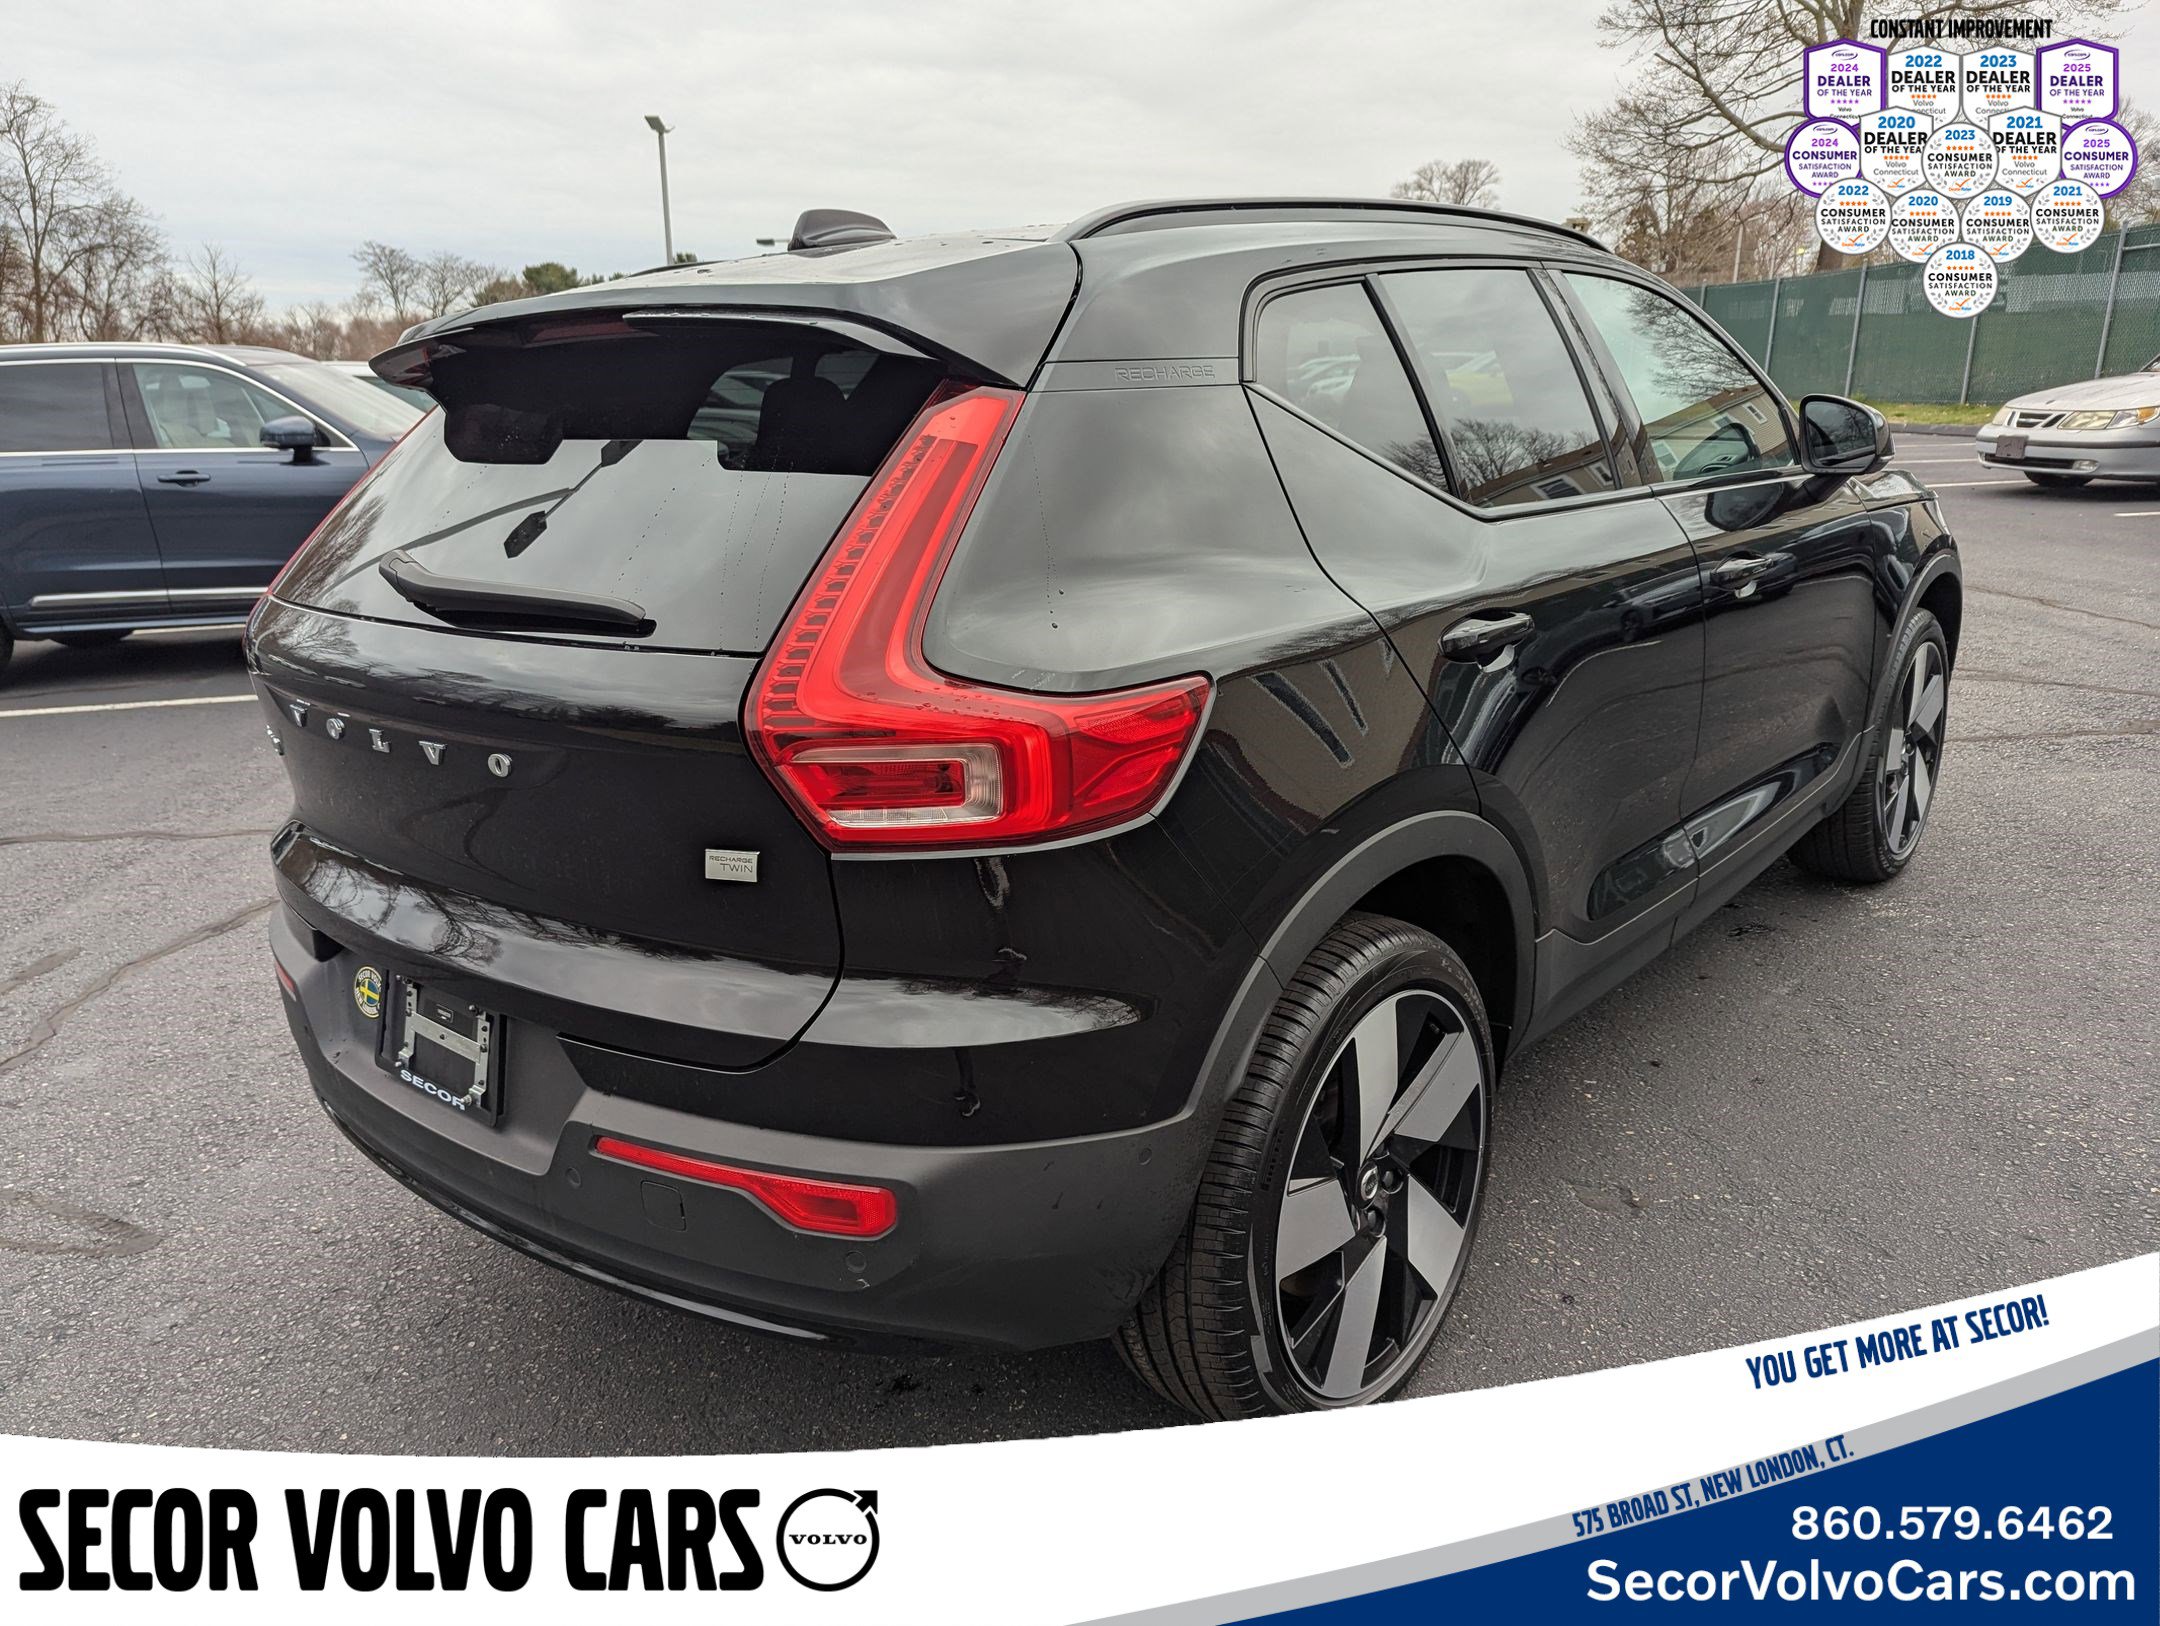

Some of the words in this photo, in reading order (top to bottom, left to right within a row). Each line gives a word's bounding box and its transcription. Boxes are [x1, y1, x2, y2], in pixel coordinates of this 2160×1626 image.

[1114, 364, 1216, 382] RECHARGE
[289, 703, 513, 778] VOLVO
[708, 855, 753, 864] RECHARGE
[719, 863, 753, 873] TWIN
[400, 1069, 466, 1111] SECOR
